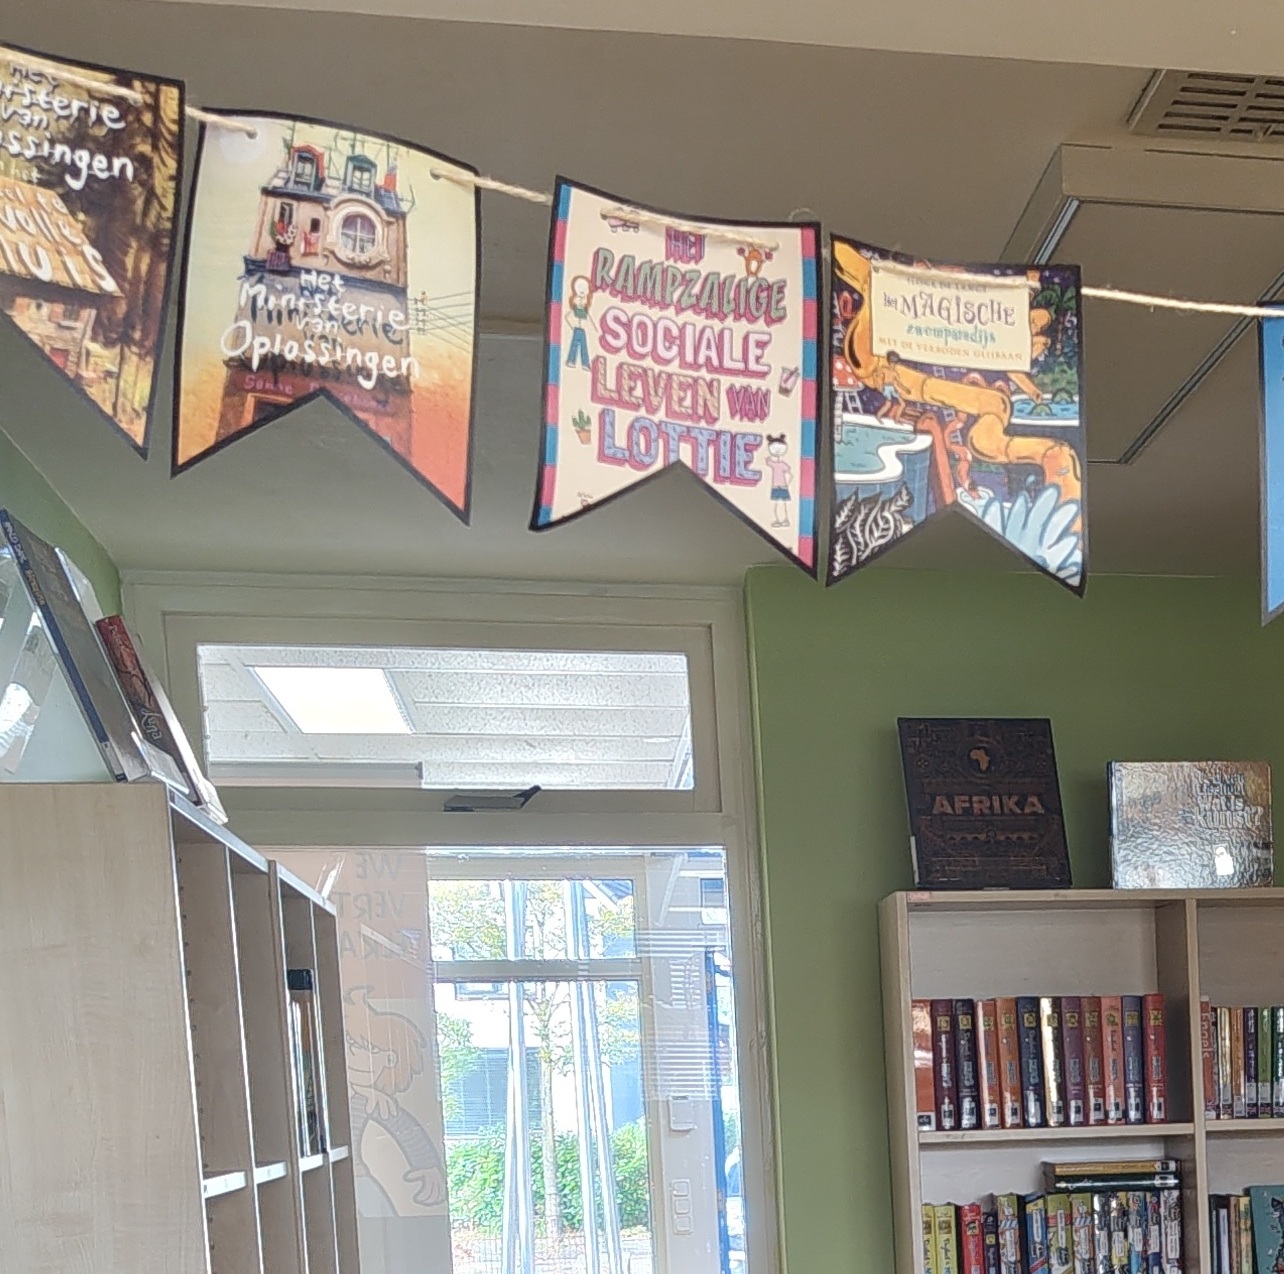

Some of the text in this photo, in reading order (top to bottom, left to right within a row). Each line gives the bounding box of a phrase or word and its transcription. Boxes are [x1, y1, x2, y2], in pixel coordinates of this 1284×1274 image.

[0, 130, 134, 191] ssingen
[240, 283, 410, 330] Ministerie
[300, 269, 346, 293] Het
[591, 247, 789, 326] RAMPZALIGE
[900, 290, 1016, 327] MAGISCHE
[220, 320, 420, 390] Oplossingen
[296, 315, 338, 334] van
[600, 305, 772, 380] SOCIALE
[591, 355, 772, 425] LEVEN VAN
[597, 408, 763, 486] LOTTIE
[932, 795, 1045, 815] AFRIKA
